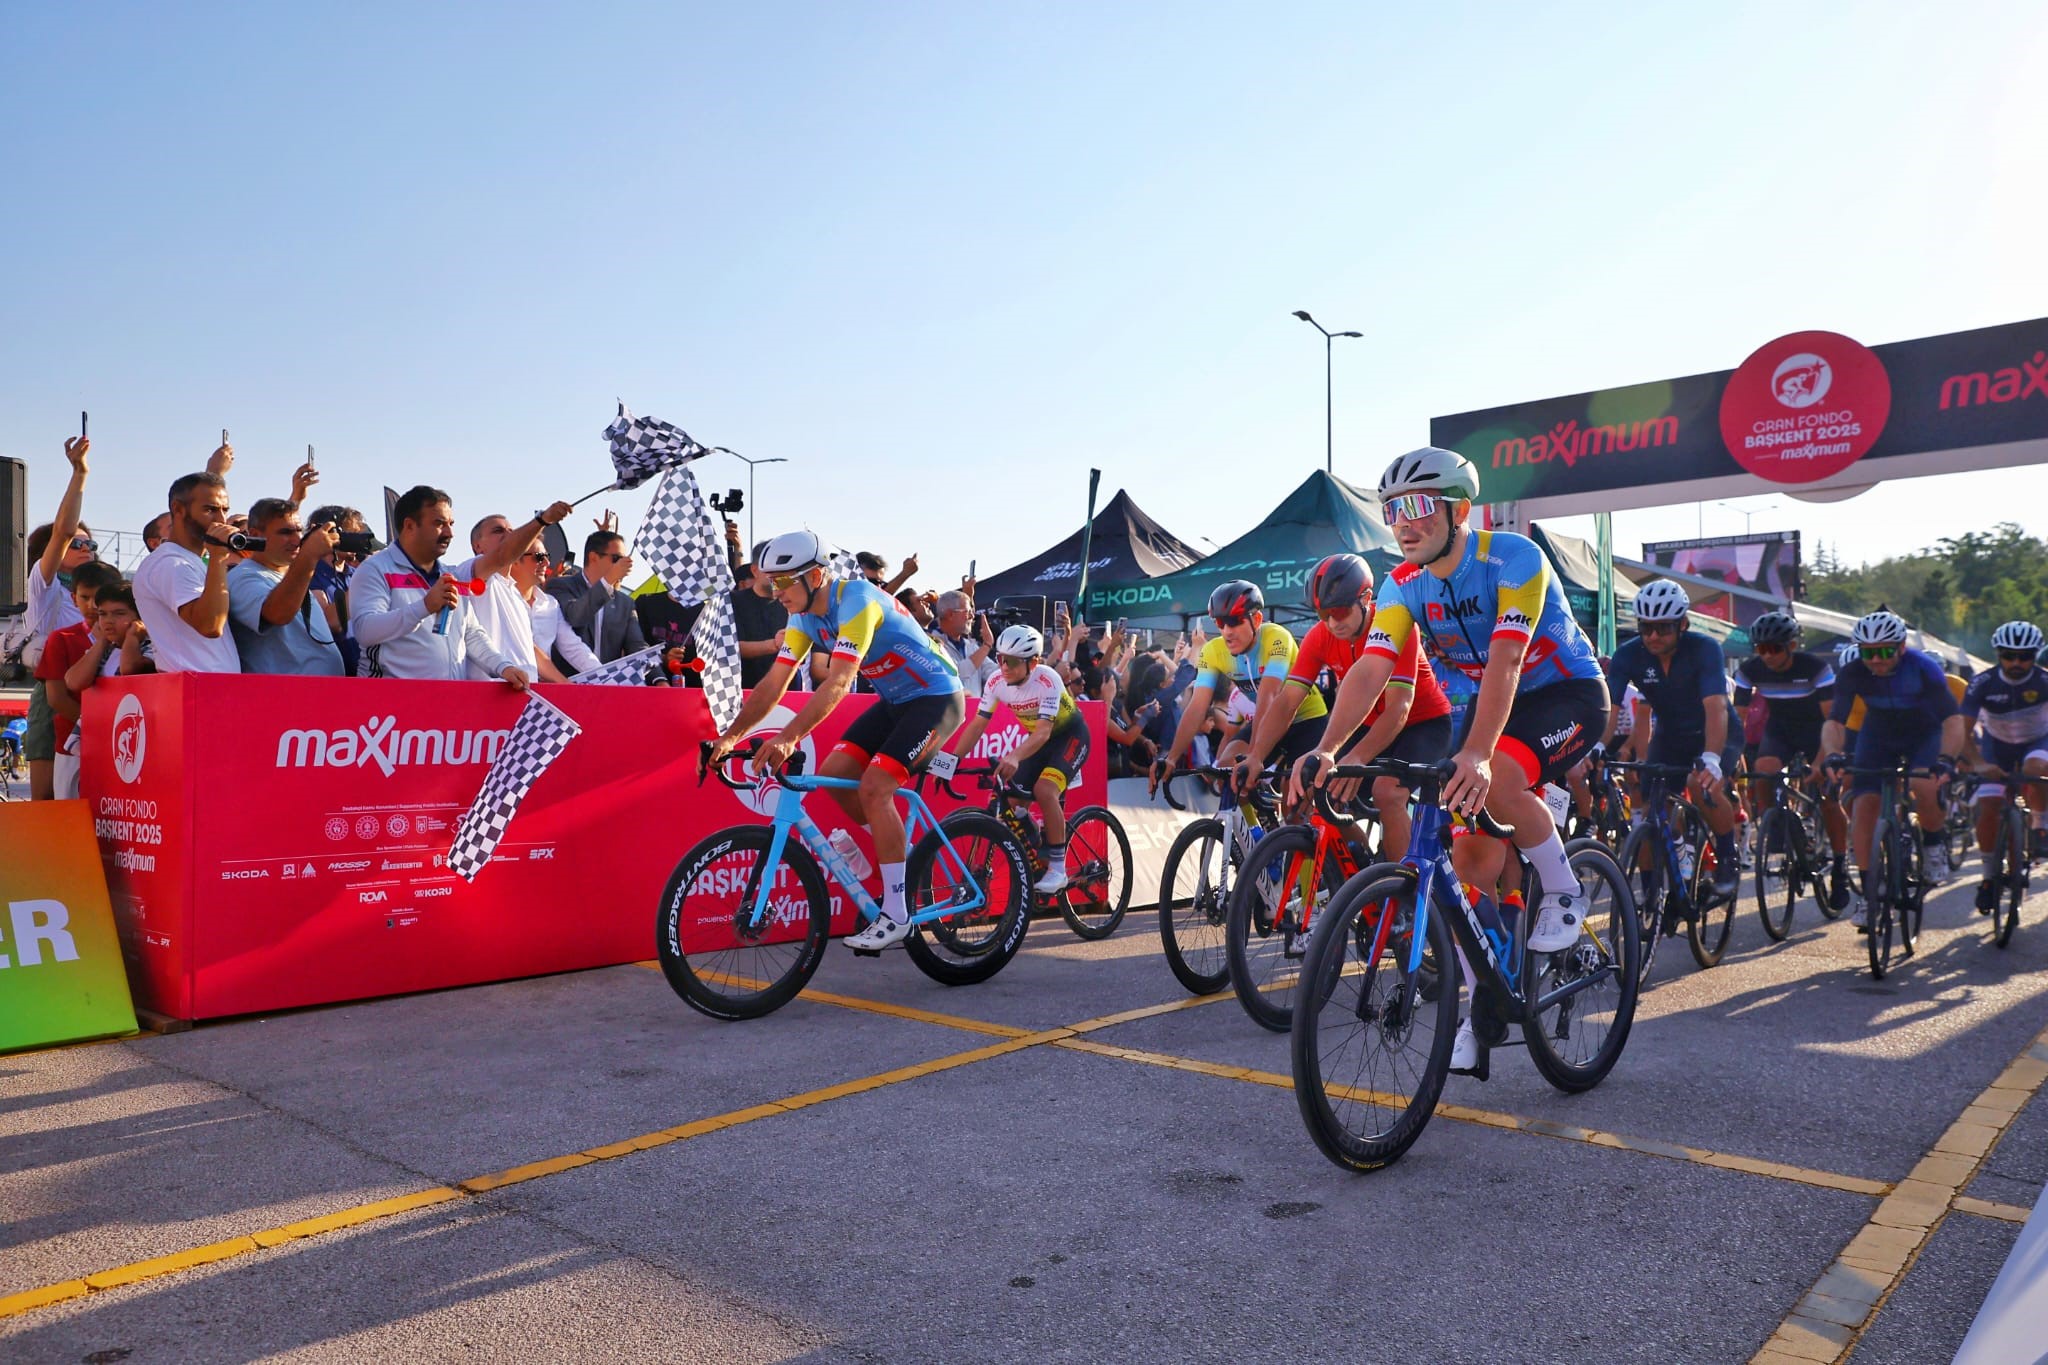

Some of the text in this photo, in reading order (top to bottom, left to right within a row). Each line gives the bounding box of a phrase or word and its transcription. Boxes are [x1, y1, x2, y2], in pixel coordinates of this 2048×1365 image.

[1753, 410, 1853, 434] GRAN FONDO
[1492, 415, 1679, 468] maximum
[1745, 422, 1861, 448] BAŞKENT 2025
[1780, 442, 1851, 460] maximum
[1266, 568, 1311, 590] SK
[1091, 584, 1173, 608] SKODA
[1427, 595, 1483, 622] RMK
[1367, 631, 1392, 643] MK
[908, 730, 932, 761] Divinol
[1540, 720, 1577, 750] Divinol
[933, 758, 951, 770] 1323
[100, 797, 157, 820] GRAN FONDO
[95, 818, 162, 845] BAŞKENT 2025
[114, 848, 156, 874] maximum
[327, 860, 372, 870] MOSSO
[529, 847, 556, 860] SPX
[221, 869, 270, 880] SKODA
[359, 890, 388, 903] ROVA
[424, 887, 453, 898] KORU
[668, 839, 733, 957] BONTRAGER
[1003, 840, 1029, 953] BONTRAGER
[697, 914, 728, 926] powered
[0, 899, 80, 969] R
